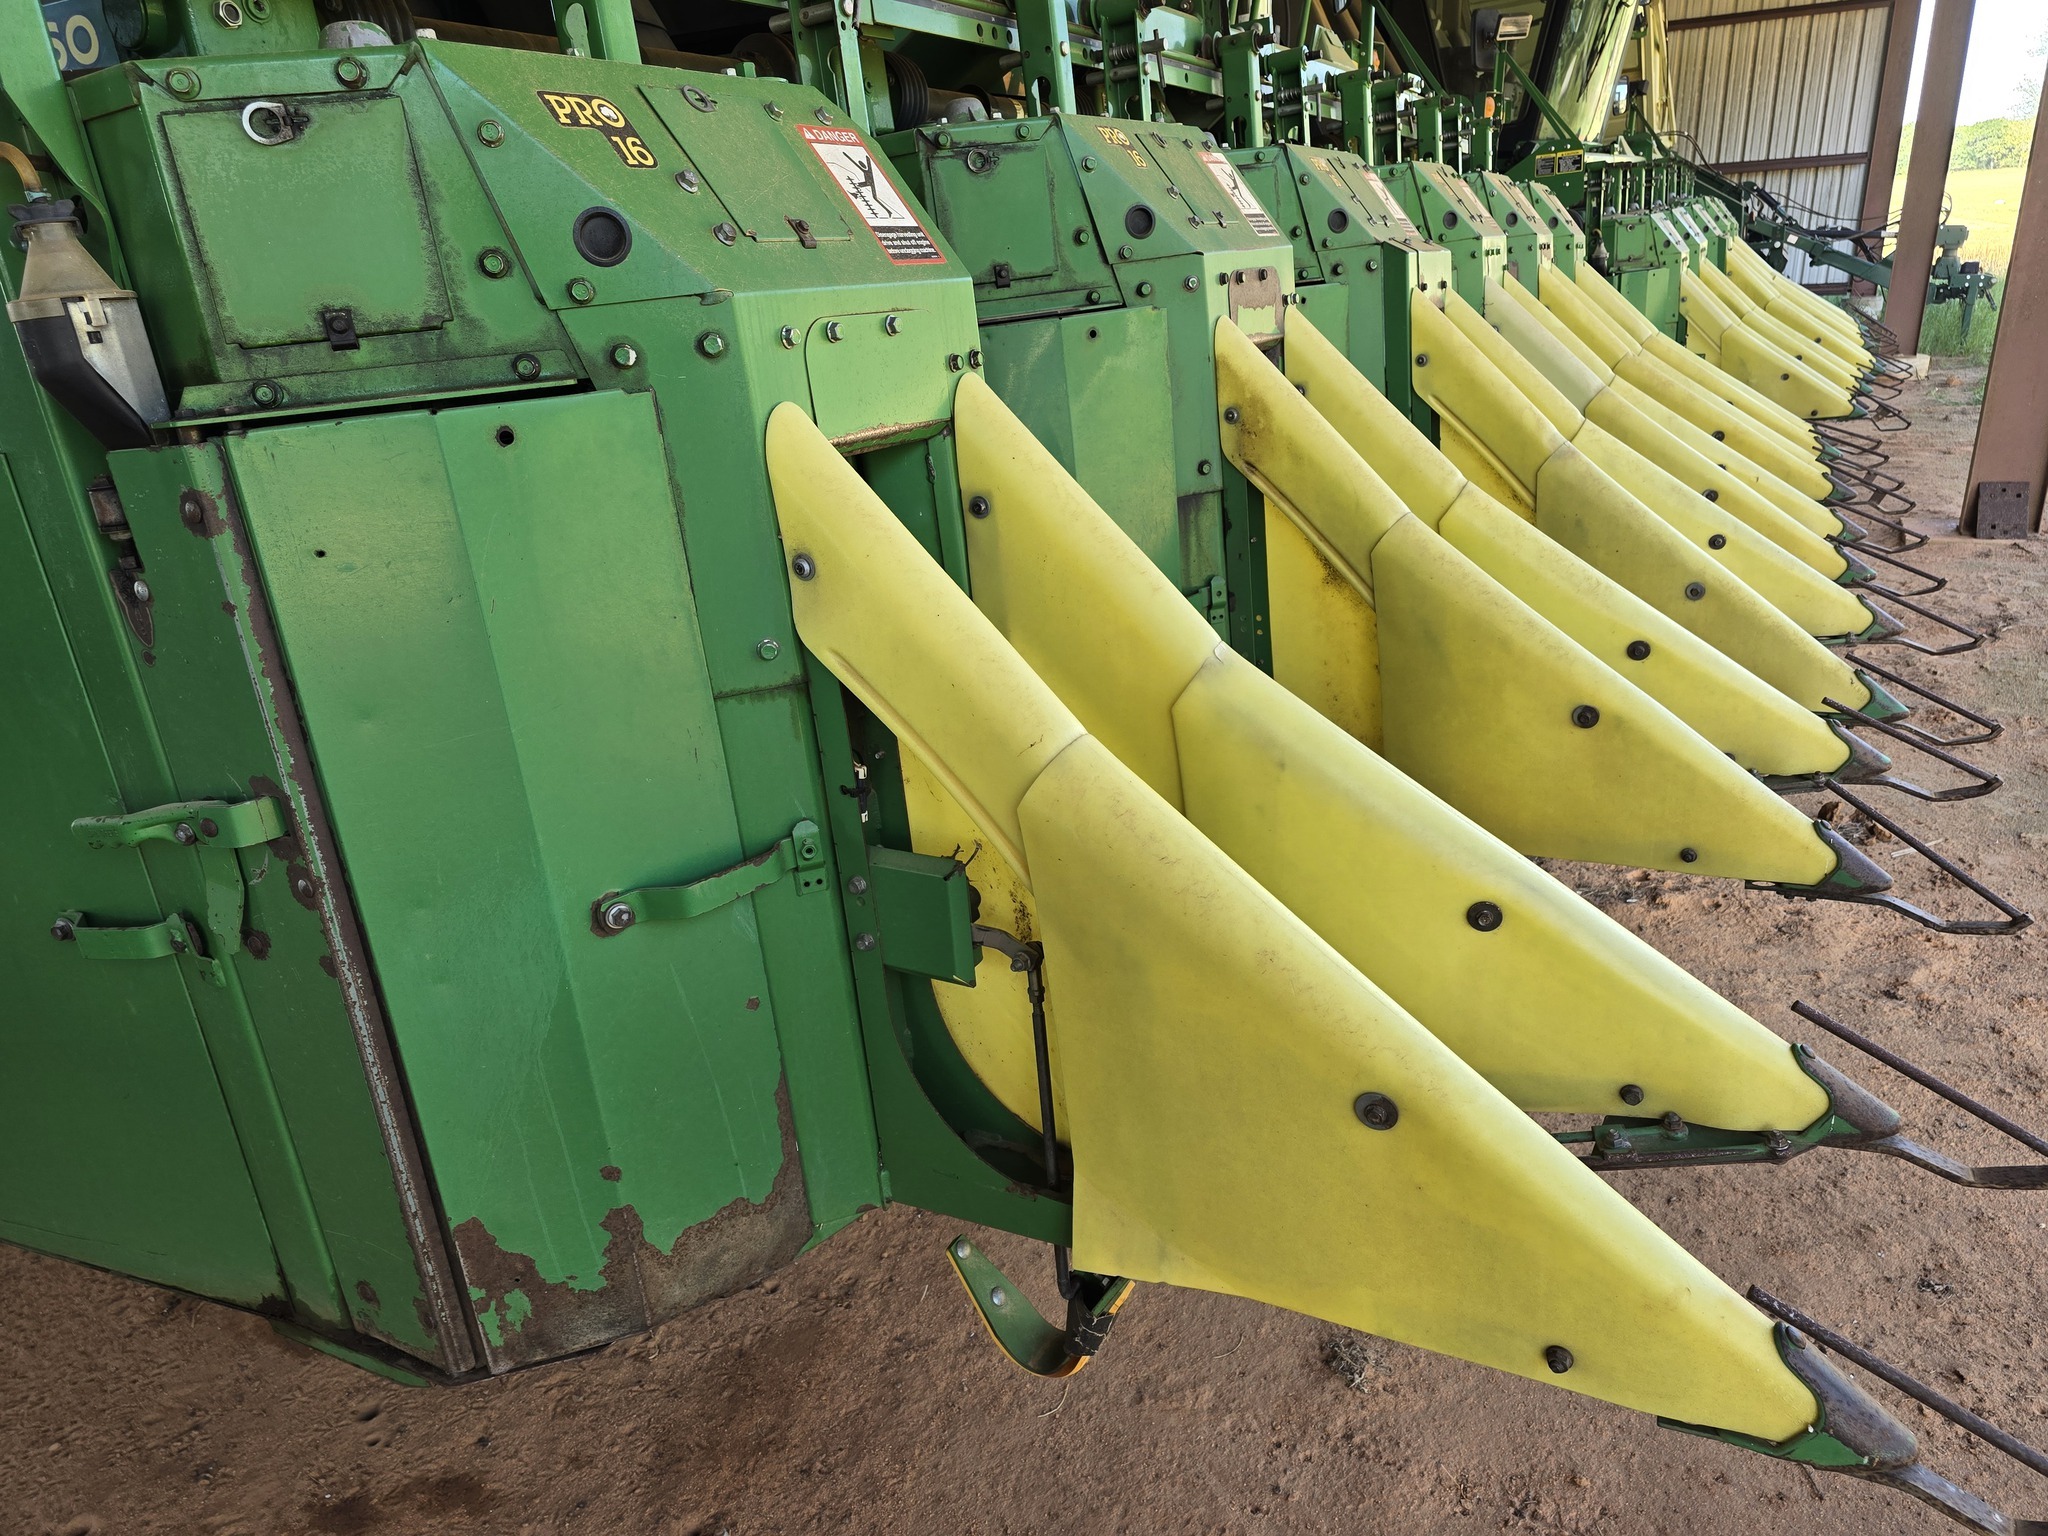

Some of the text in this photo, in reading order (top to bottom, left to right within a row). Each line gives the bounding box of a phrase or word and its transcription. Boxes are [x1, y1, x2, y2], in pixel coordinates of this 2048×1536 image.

[543, 94, 626, 128] PRO
[813, 129, 861, 144] DANGER
[1097, 126, 1130, 146] PRO
[611, 136, 655, 166] 16
[1126, 149, 1147, 167] 16
